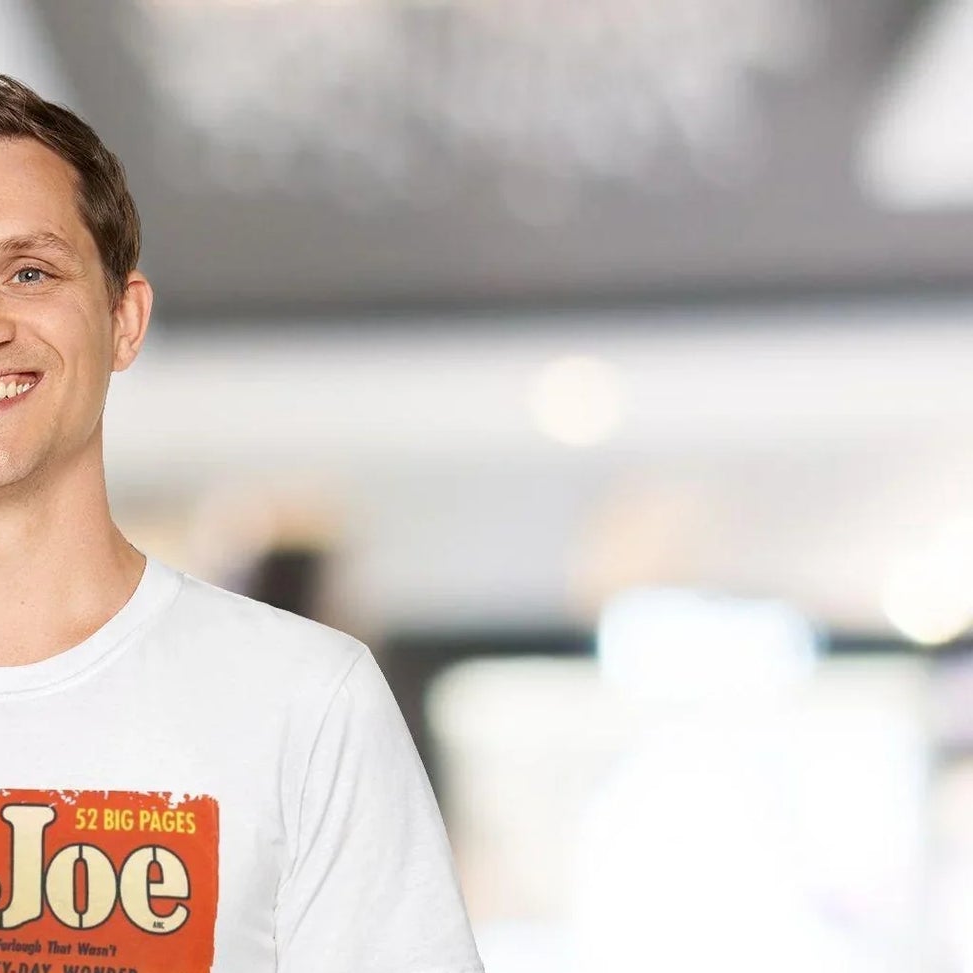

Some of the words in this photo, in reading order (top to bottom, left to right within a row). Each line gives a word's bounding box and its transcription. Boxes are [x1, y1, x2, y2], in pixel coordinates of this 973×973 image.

[75, 808, 98, 830] 52
[103, 808, 134, 831] BIG
[139, 809, 196, 834] PAGES
[47, 941, 71, 955] That
[78, 942, 117, 957] Wasn't
